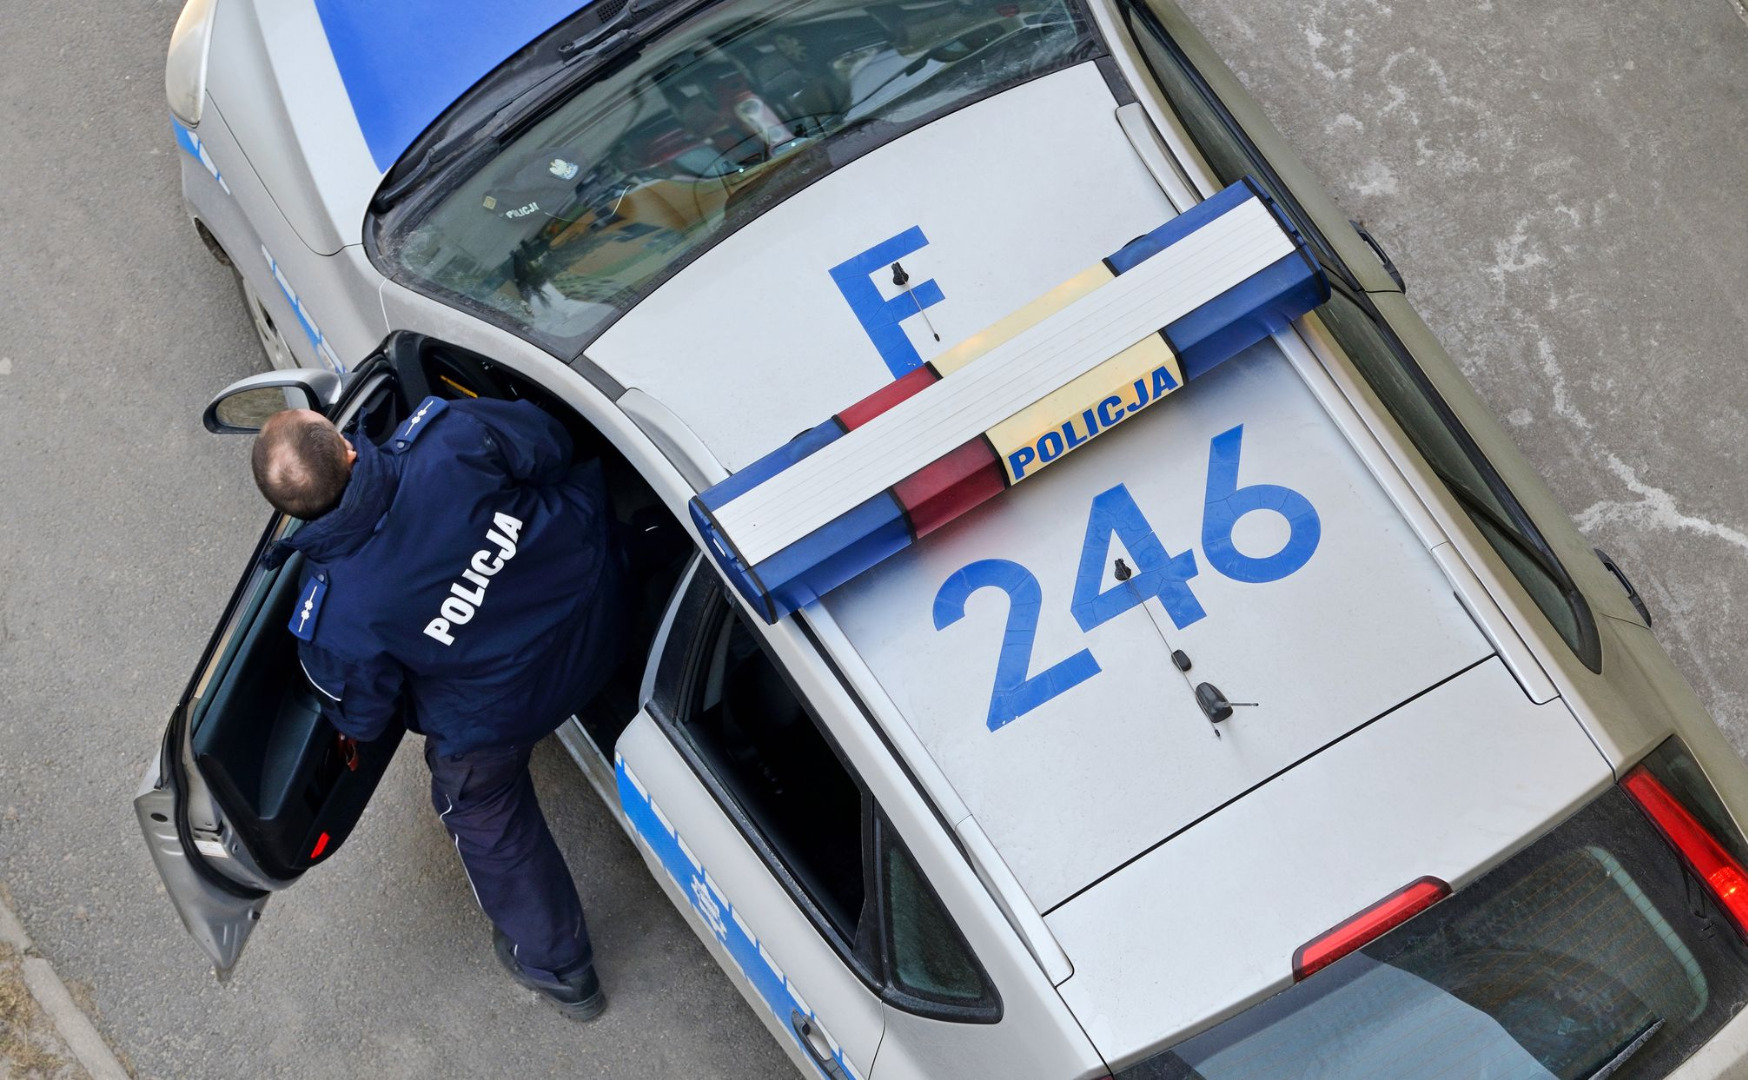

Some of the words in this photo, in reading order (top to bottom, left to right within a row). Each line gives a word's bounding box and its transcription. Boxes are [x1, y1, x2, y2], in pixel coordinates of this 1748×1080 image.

[828, 225, 945, 380] F
[1008, 365, 1179, 480] POLICJA
[423, 511, 523, 646] POLICJA
[933, 423, 1321, 732] 246
